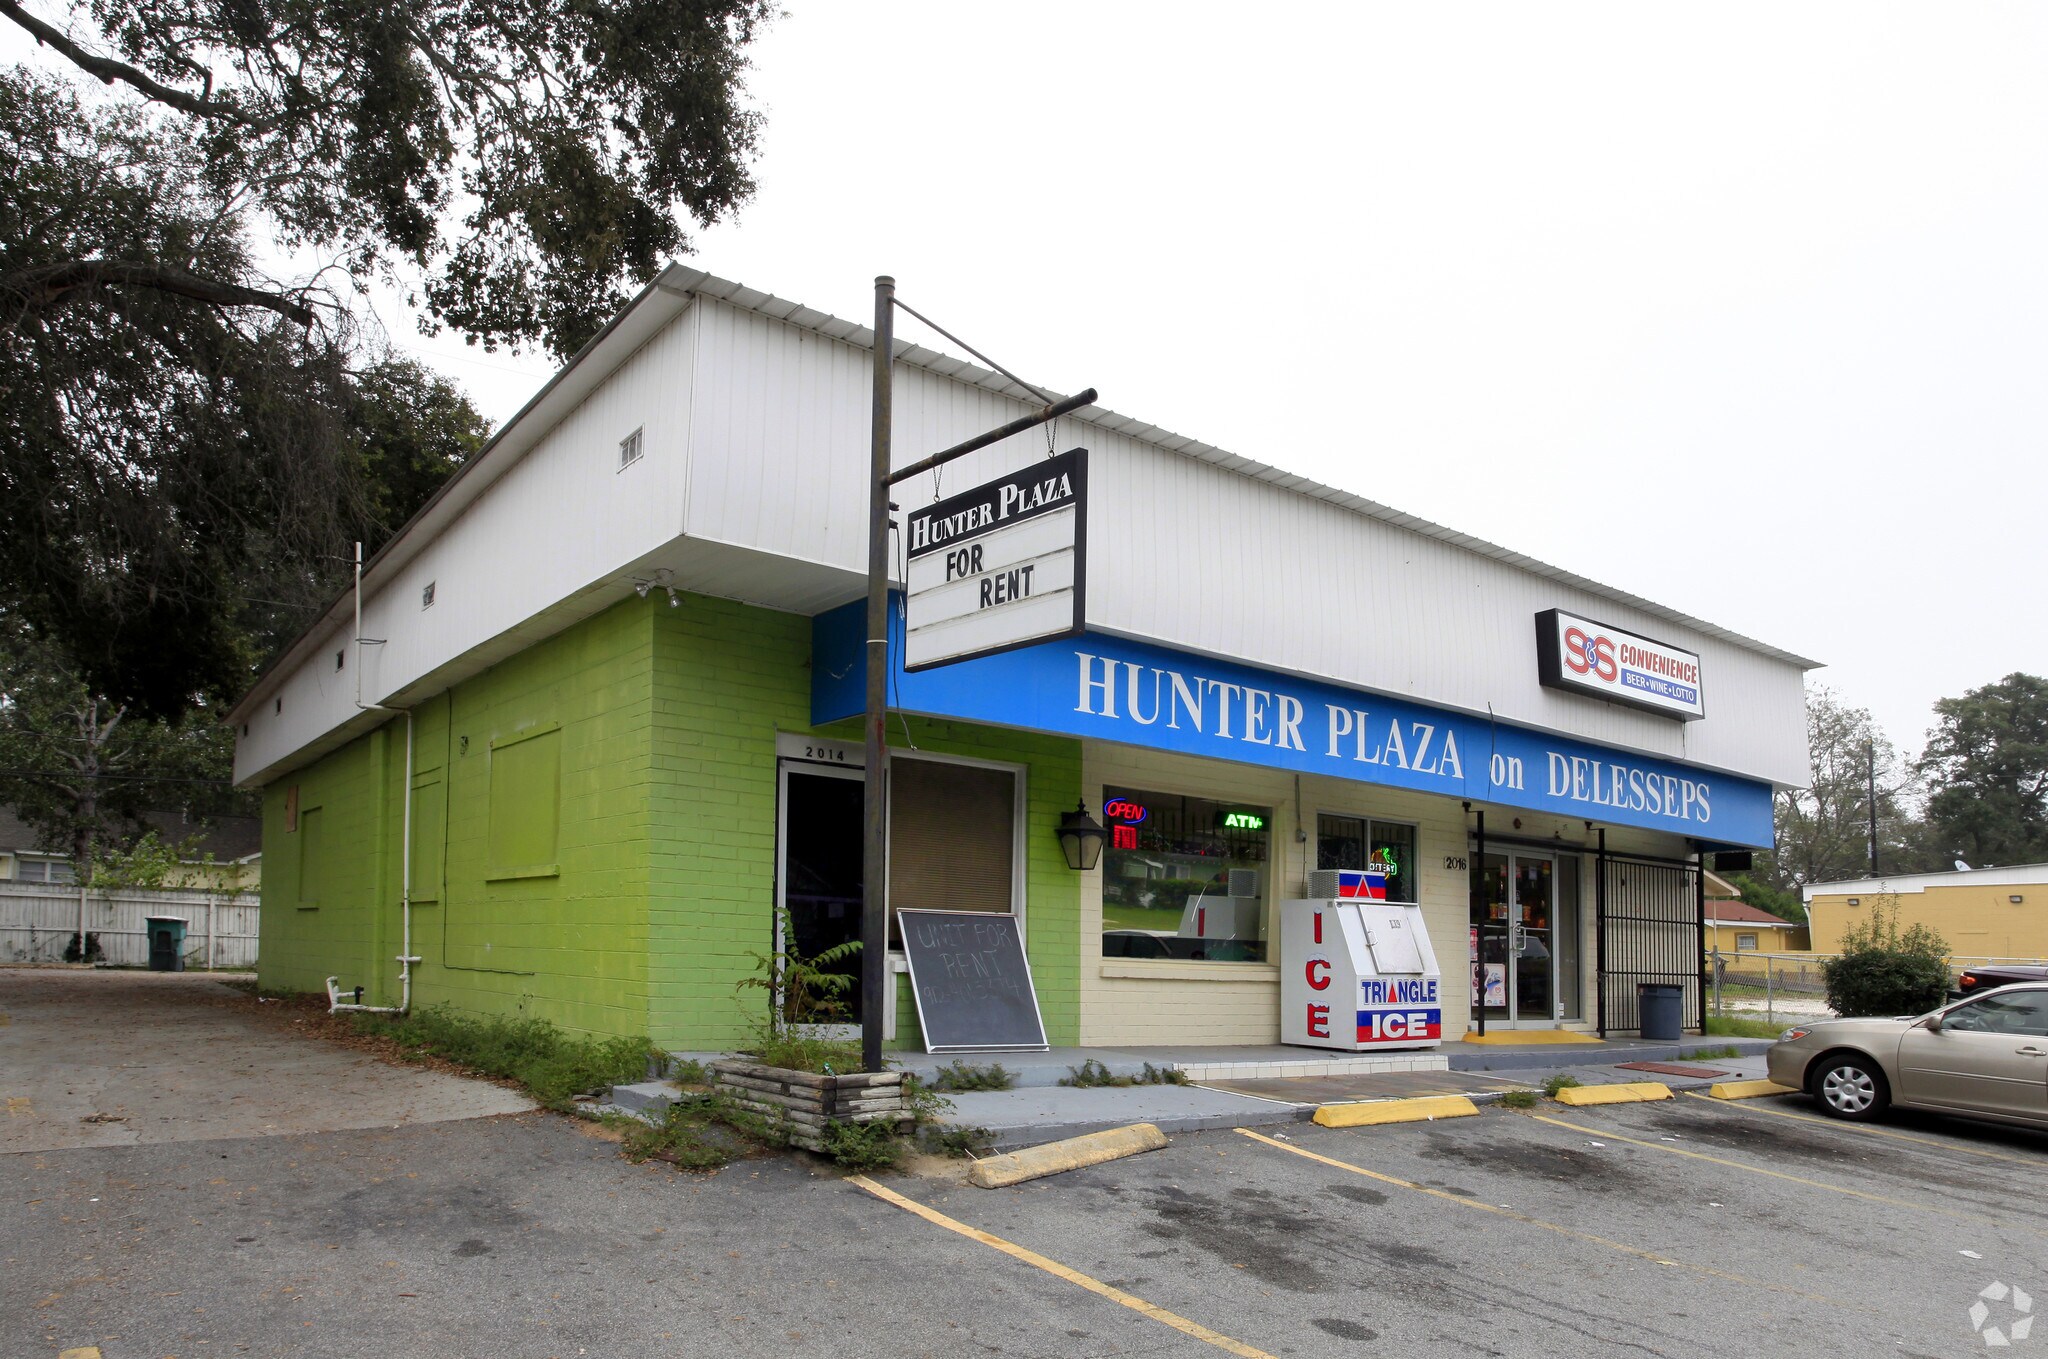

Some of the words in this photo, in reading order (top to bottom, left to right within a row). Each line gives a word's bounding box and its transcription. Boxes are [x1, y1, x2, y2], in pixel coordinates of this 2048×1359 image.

[910, 502, 994, 551] HUNTER
[998, 472, 1073, 521] PLAZA
[946, 543, 983, 582] FOR
[979, 565, 1034, 609] RENT
[1564, 625, 1618, 684] S&S
[1619, 643, 1697, 684] CONVENIENCE
[1626, 672, 1646, 688] BEER
[1649, 679, 1669, 695] WINE
[1672, 686, 1694, 702] LOTTO
[1073, 651, 1307, 752] HUNTER
[1325, 704, 1465, 779] PLAZA
[1490, 753, 1524, 790] on
[1546, 751, 1711, 823] DELESSEPS
[806, 746, 844, 761] 2014
[1107, 801, 1144, 820] OPEN
[1445, 856, 1467, 871] 2016
[974, 923, 1013, 948] FOR
[940, 949, 1002, 978] RENT
[1361, 977, 1437, 1005] TRIANGLE
[1371, 1012, 1429, 1039] ICE
